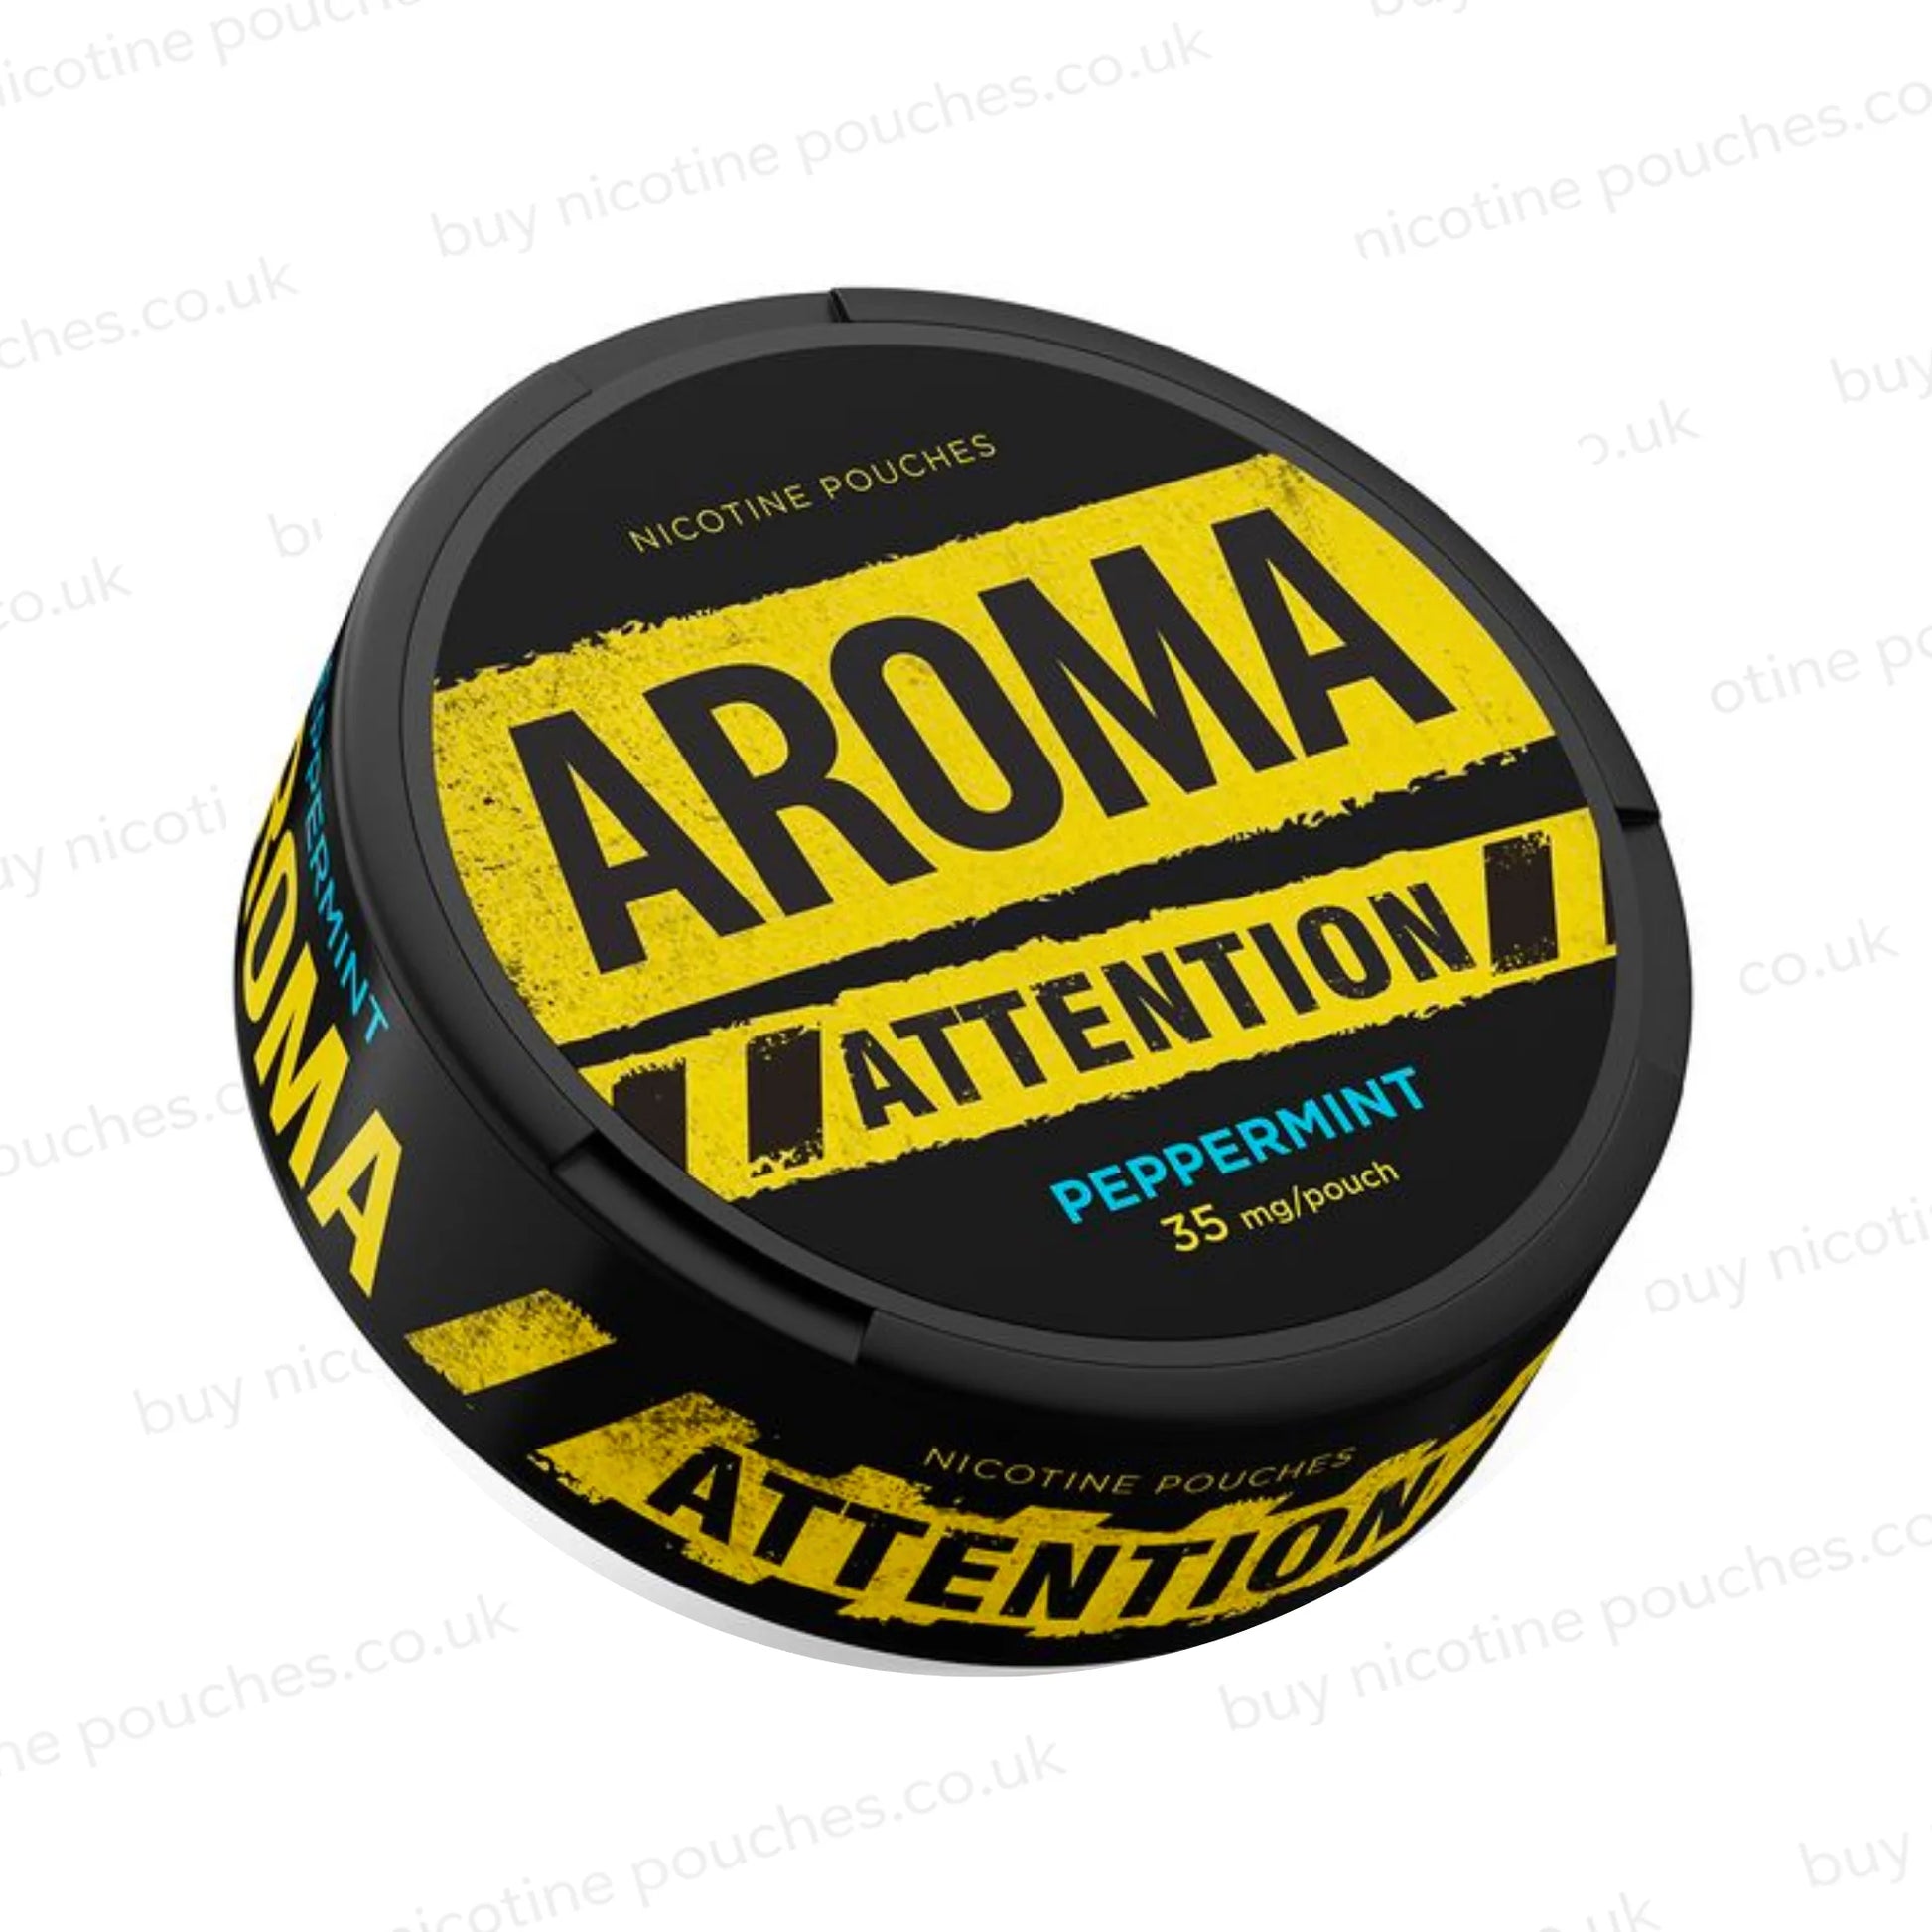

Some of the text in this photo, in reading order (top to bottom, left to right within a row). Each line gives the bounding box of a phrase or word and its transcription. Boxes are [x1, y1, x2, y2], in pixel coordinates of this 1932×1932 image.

[628, 433, 997, 554] NICOTINE POUCHES
[508, 507, 1456, 975] AROMA
[839, 882, 1477, 1131] ATTENTION
[1049, 1065, 1426, 1226] PEPPERMINT
[1159, 1160, 1401, 1253] 35 mg/pouch
[646, 1444, 1434, 1621] ATTENTION
[923, 1446, 1358, 1496] NICOTINE POUCHES
